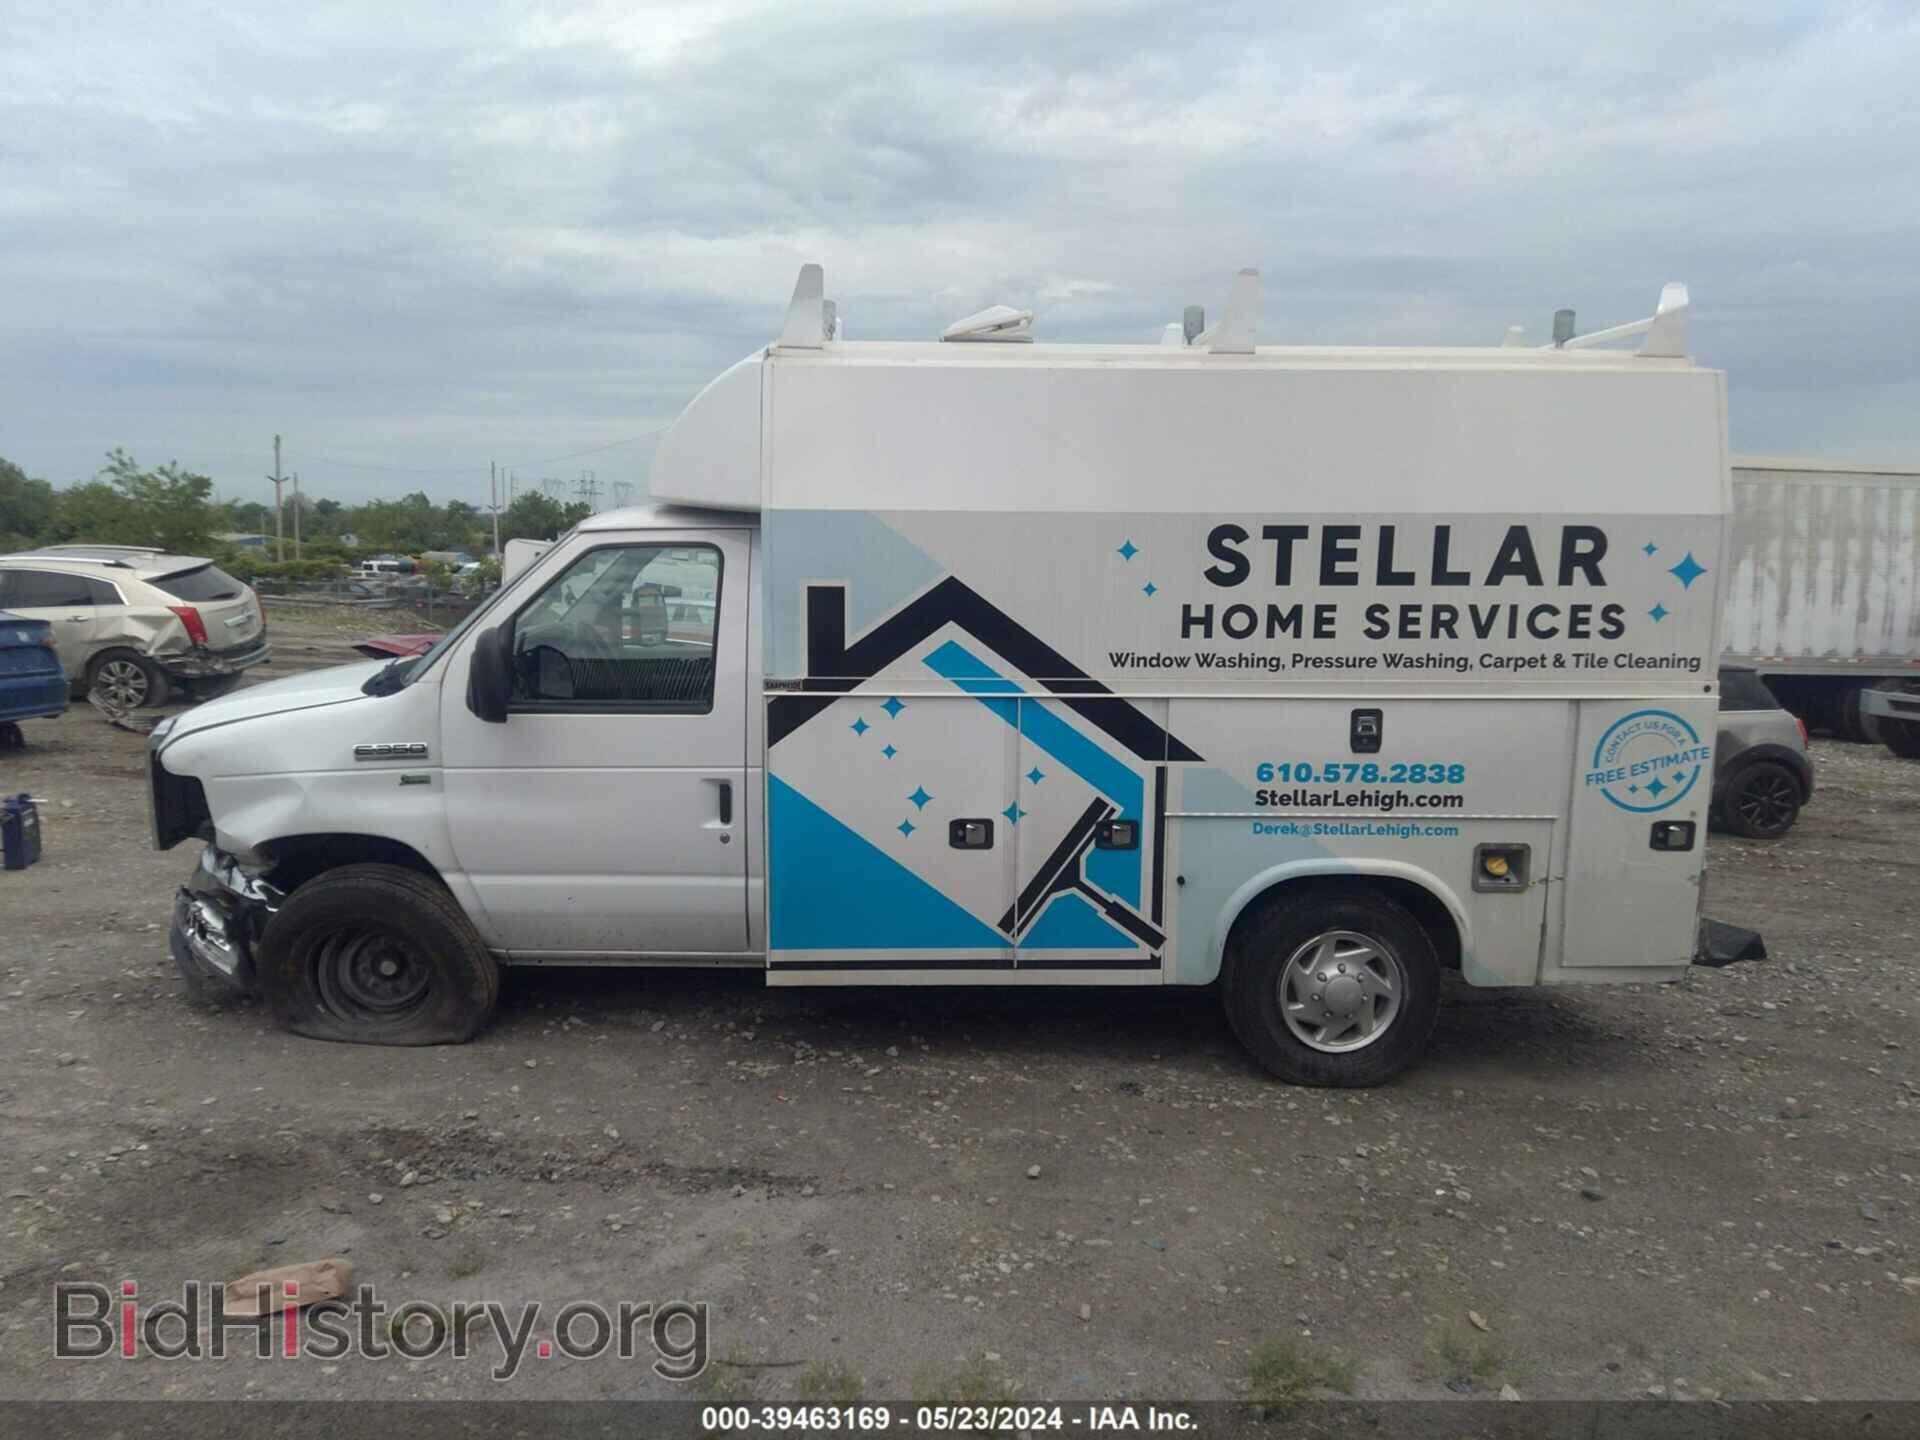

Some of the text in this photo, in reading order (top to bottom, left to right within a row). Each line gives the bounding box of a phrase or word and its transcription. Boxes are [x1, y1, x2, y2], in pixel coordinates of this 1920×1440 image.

[1204, 524, 1609, 587] STELLAR
[1181, 603, 1626, 640] HOME SERVICES
[1109, 652, 1702, 673] Window Washing, Pressure Washing, Carpet & Tile Cleaning
[1604, 722, 1641, 763] CONTACT
[1644, 721, 1660, 730] US
[1256, 763, 1465, 784] 610.578.2838
[1585, 746, 1711, 787] FREE ESTIMATE
[1255, 789, 1464, 812] StellarLehigh.com
[1253, 822, 1459, 838] Derek@StellarLehigh.com
